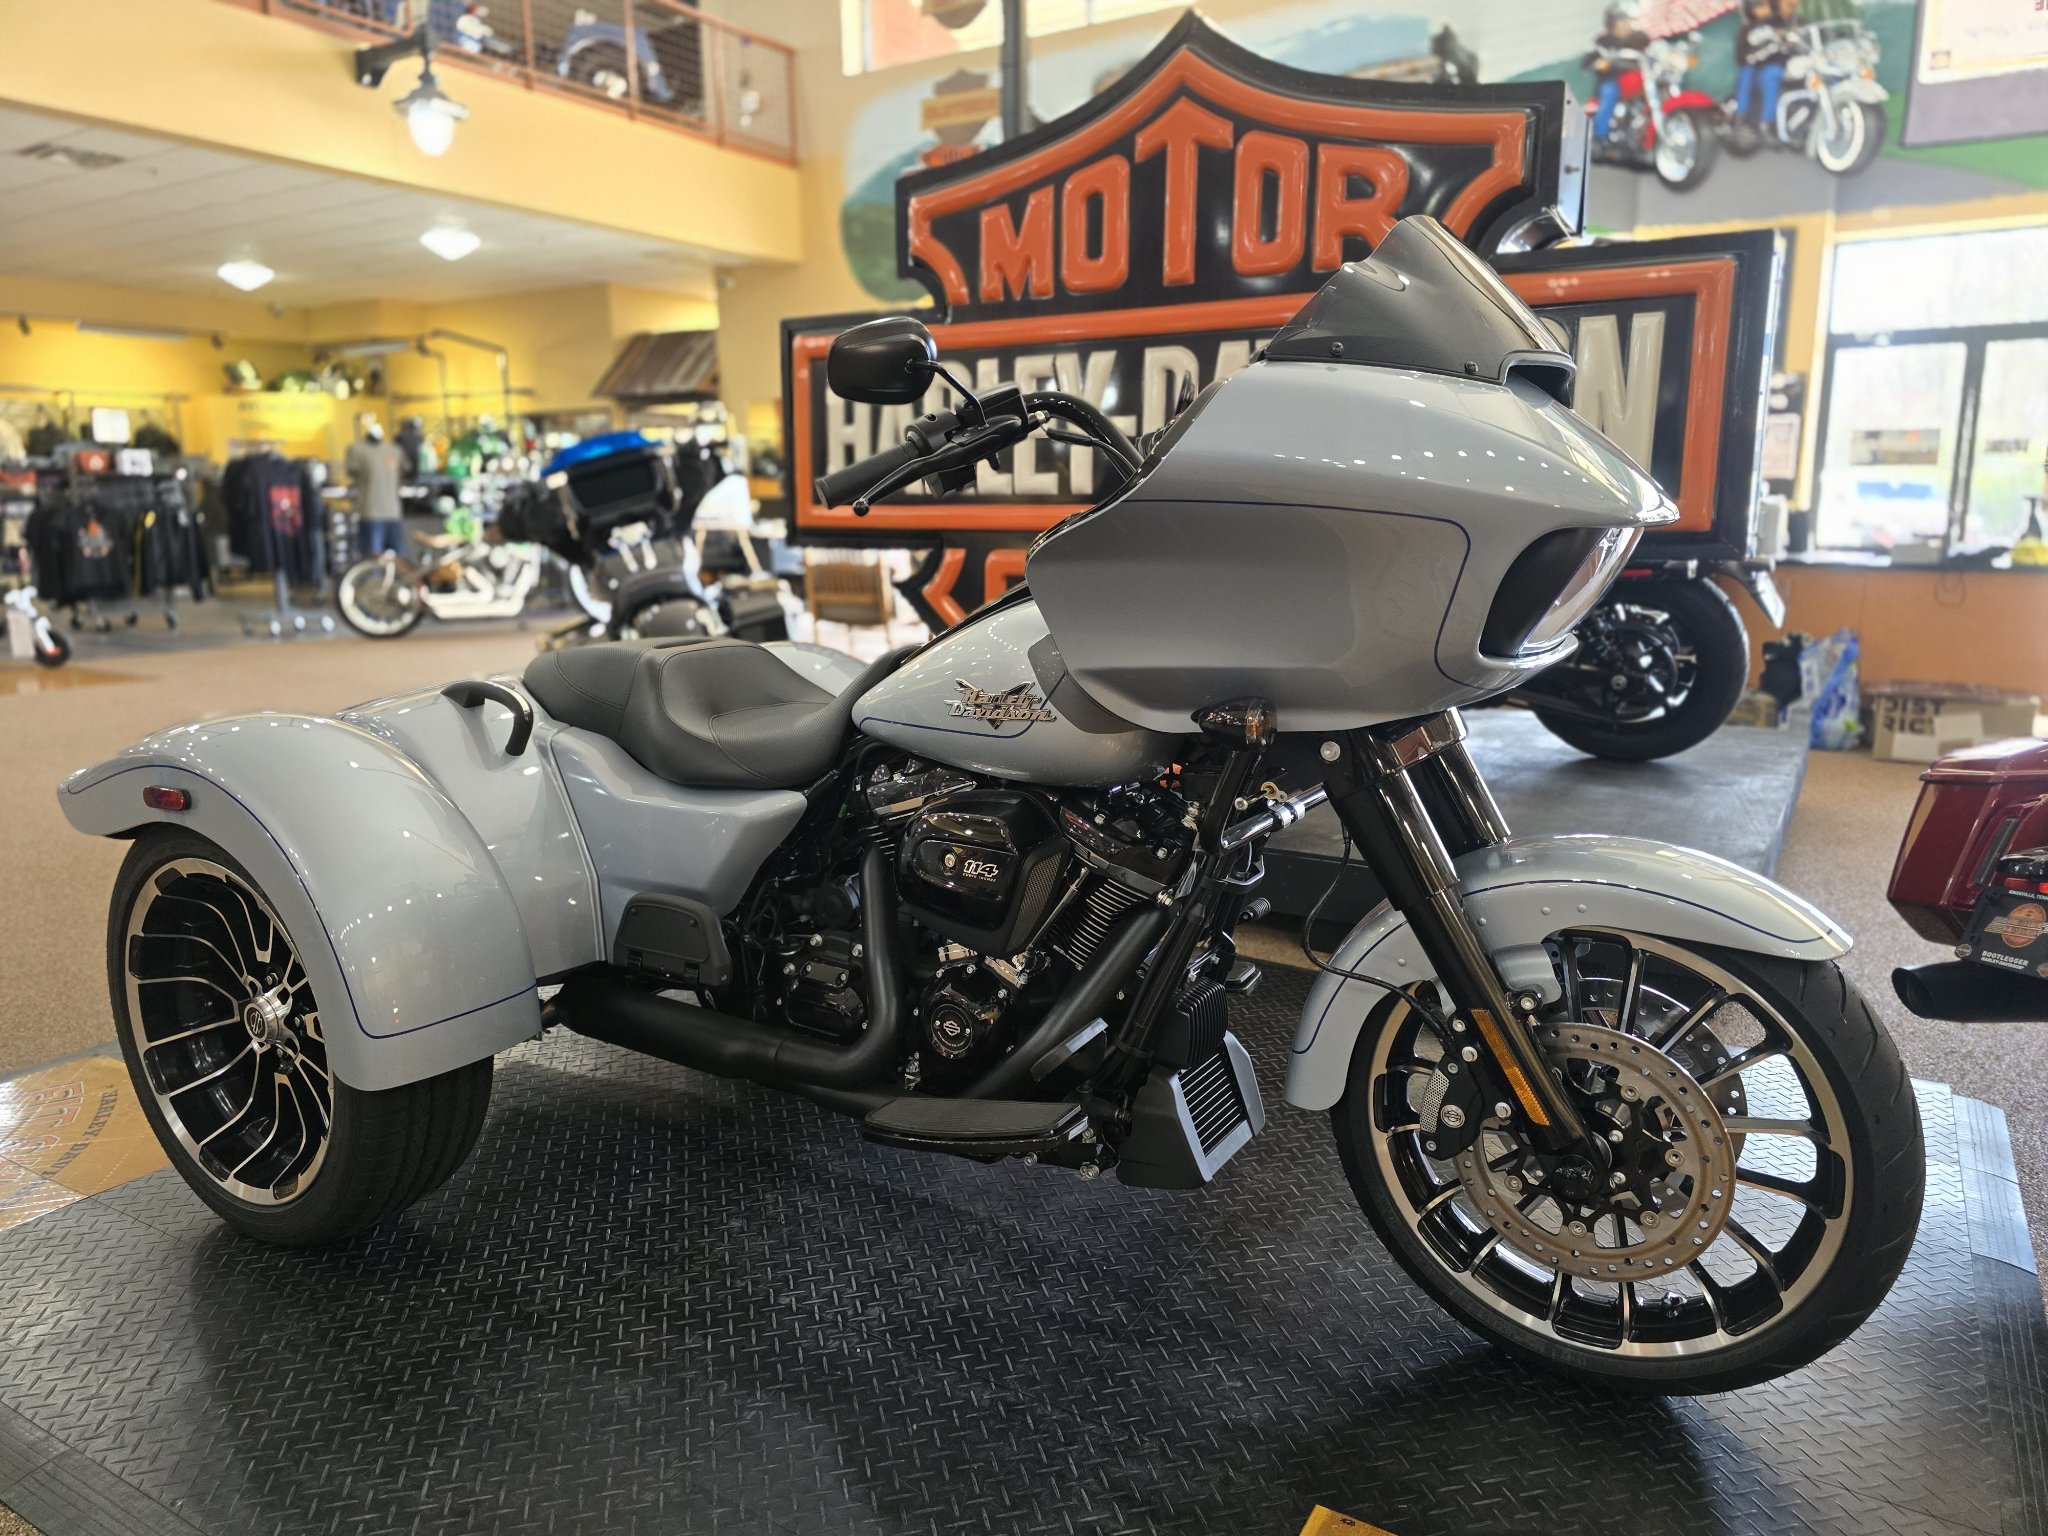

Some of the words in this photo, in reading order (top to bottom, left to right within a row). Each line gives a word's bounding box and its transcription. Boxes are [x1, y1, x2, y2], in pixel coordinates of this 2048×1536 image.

[980, 97, 1409, 302] MOTOR
[955, 687, 1042, 709] Harley
[945, 700, 1057, 721] Davidson
[1884, 716, 1934, 735] RIC
[963, 859, 999, 877] 114
[1981, 950, 2029, 966] BOOTLEGGER
